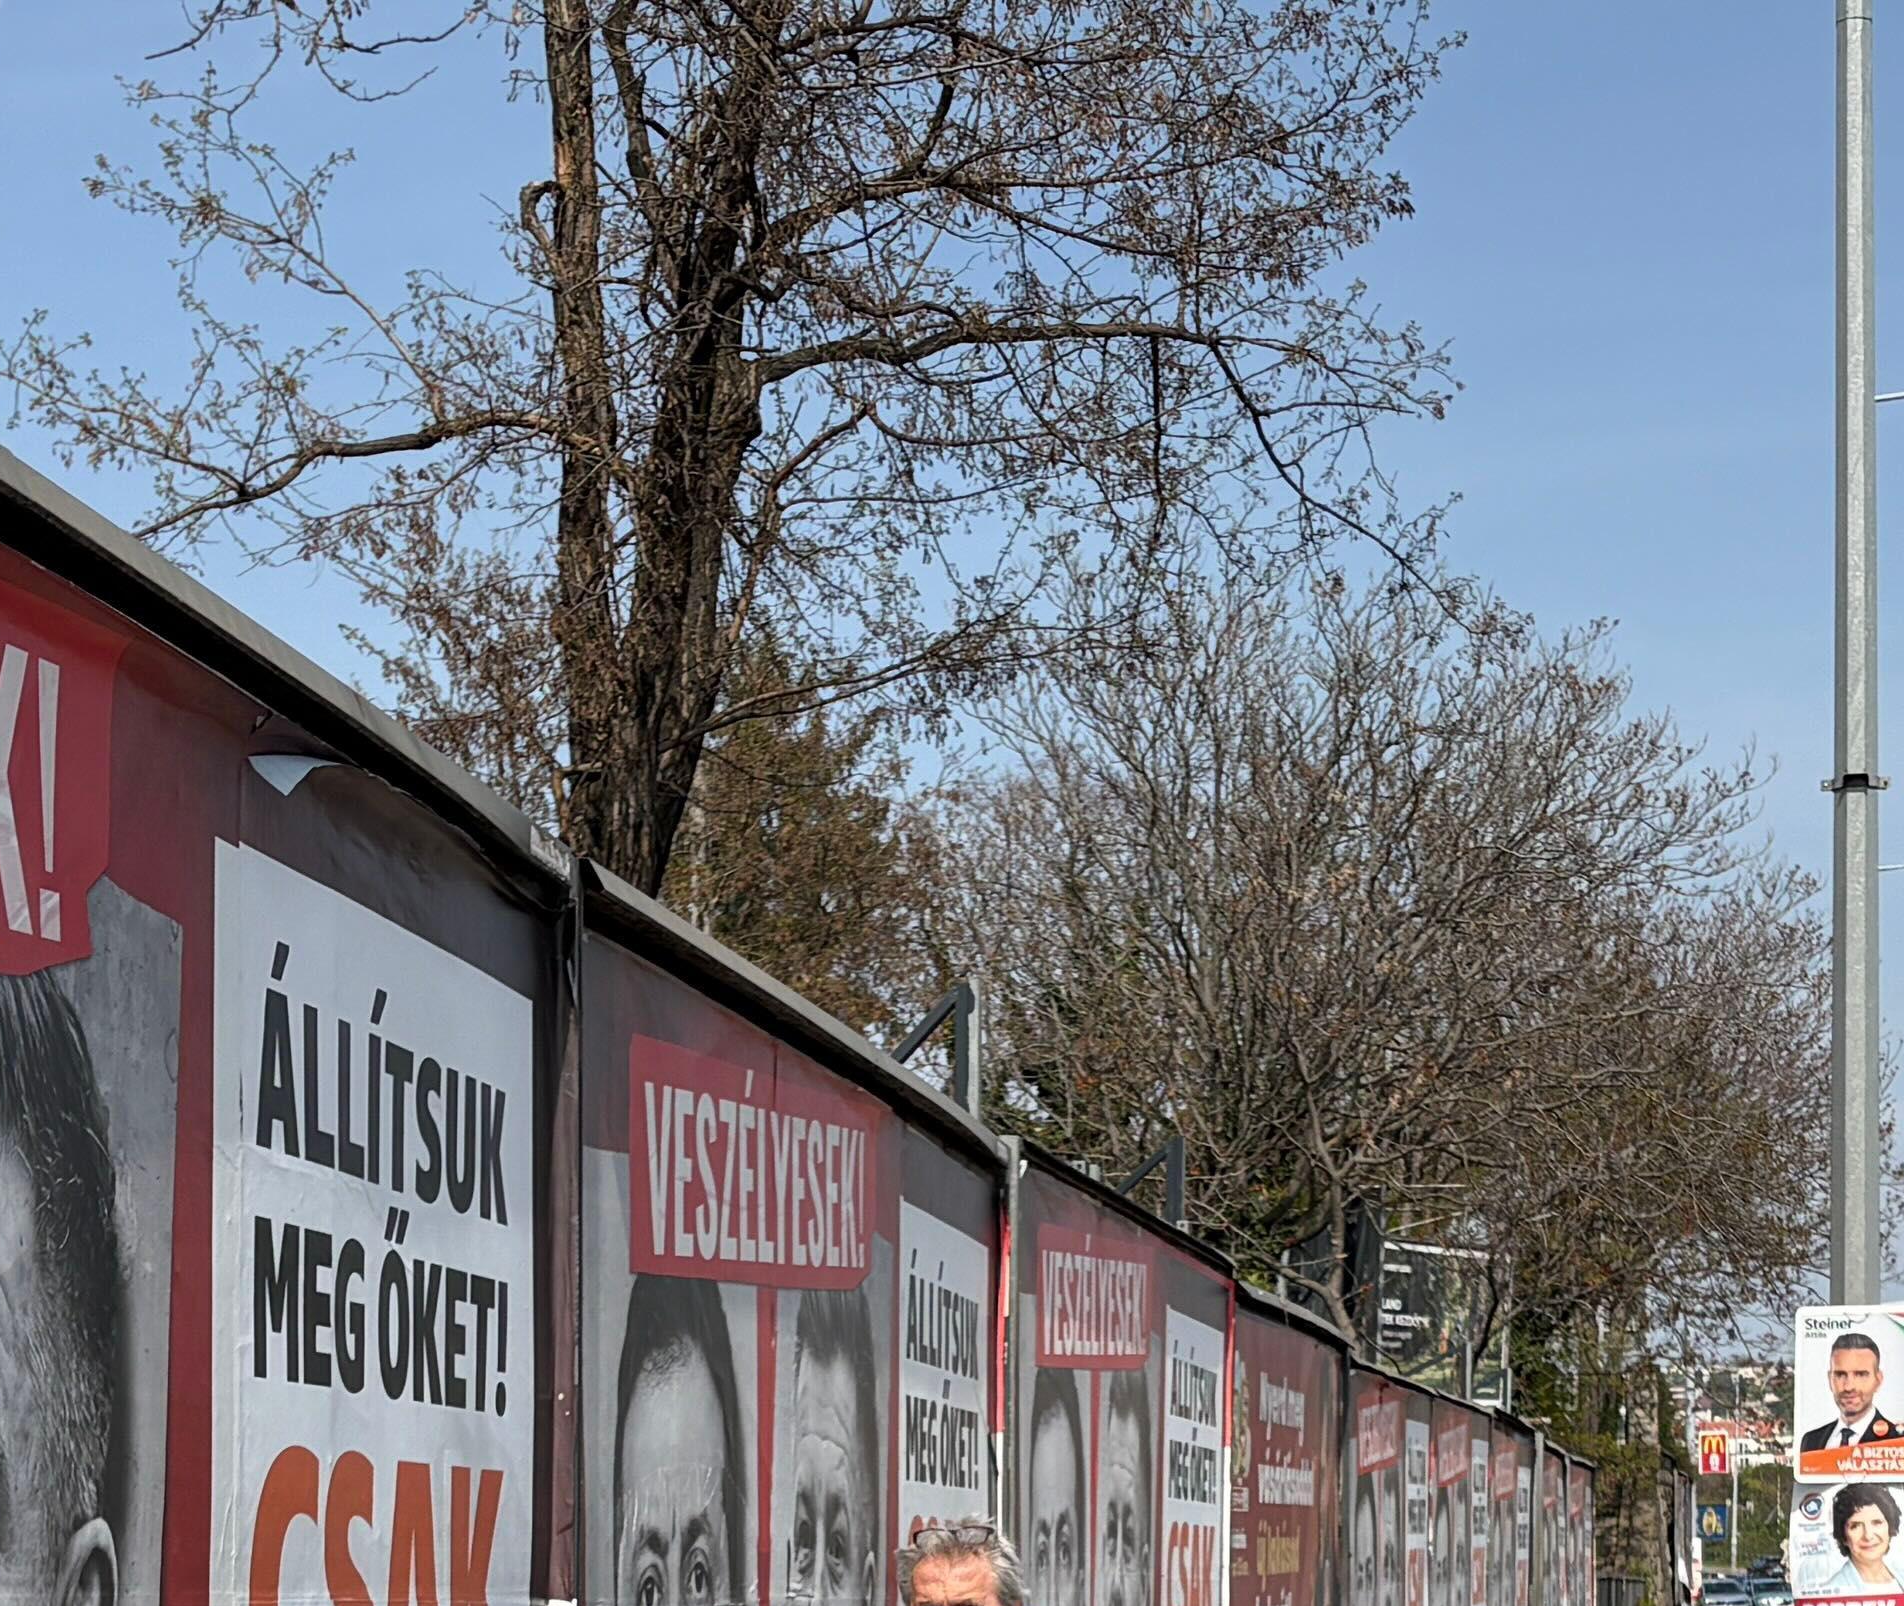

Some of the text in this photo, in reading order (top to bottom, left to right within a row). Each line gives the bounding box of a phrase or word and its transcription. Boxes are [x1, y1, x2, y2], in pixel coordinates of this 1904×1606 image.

[256, 942, 507, 1226] ÁLLÍTSUK
[644, 1069, 865, 1269] VESZÉLYESEK!
[254, 1208, 509, 1418] MEG ŐKET!
[907, 1248, 979, 1381] ÁLLÍTSUK
[1042, 1234, 1148, 1357] VESZÉLYESEK!
[1805, 1317, 1855, 1331] Steiner
[906, 1379, 979, 1490] MEG ŐKET!
[1170, 1340, 1217, 1427] ÁLLÍTSUK
[1168, 1438, 1189, 1501] MEG
[1852, 1446, 1864, 1459] A
